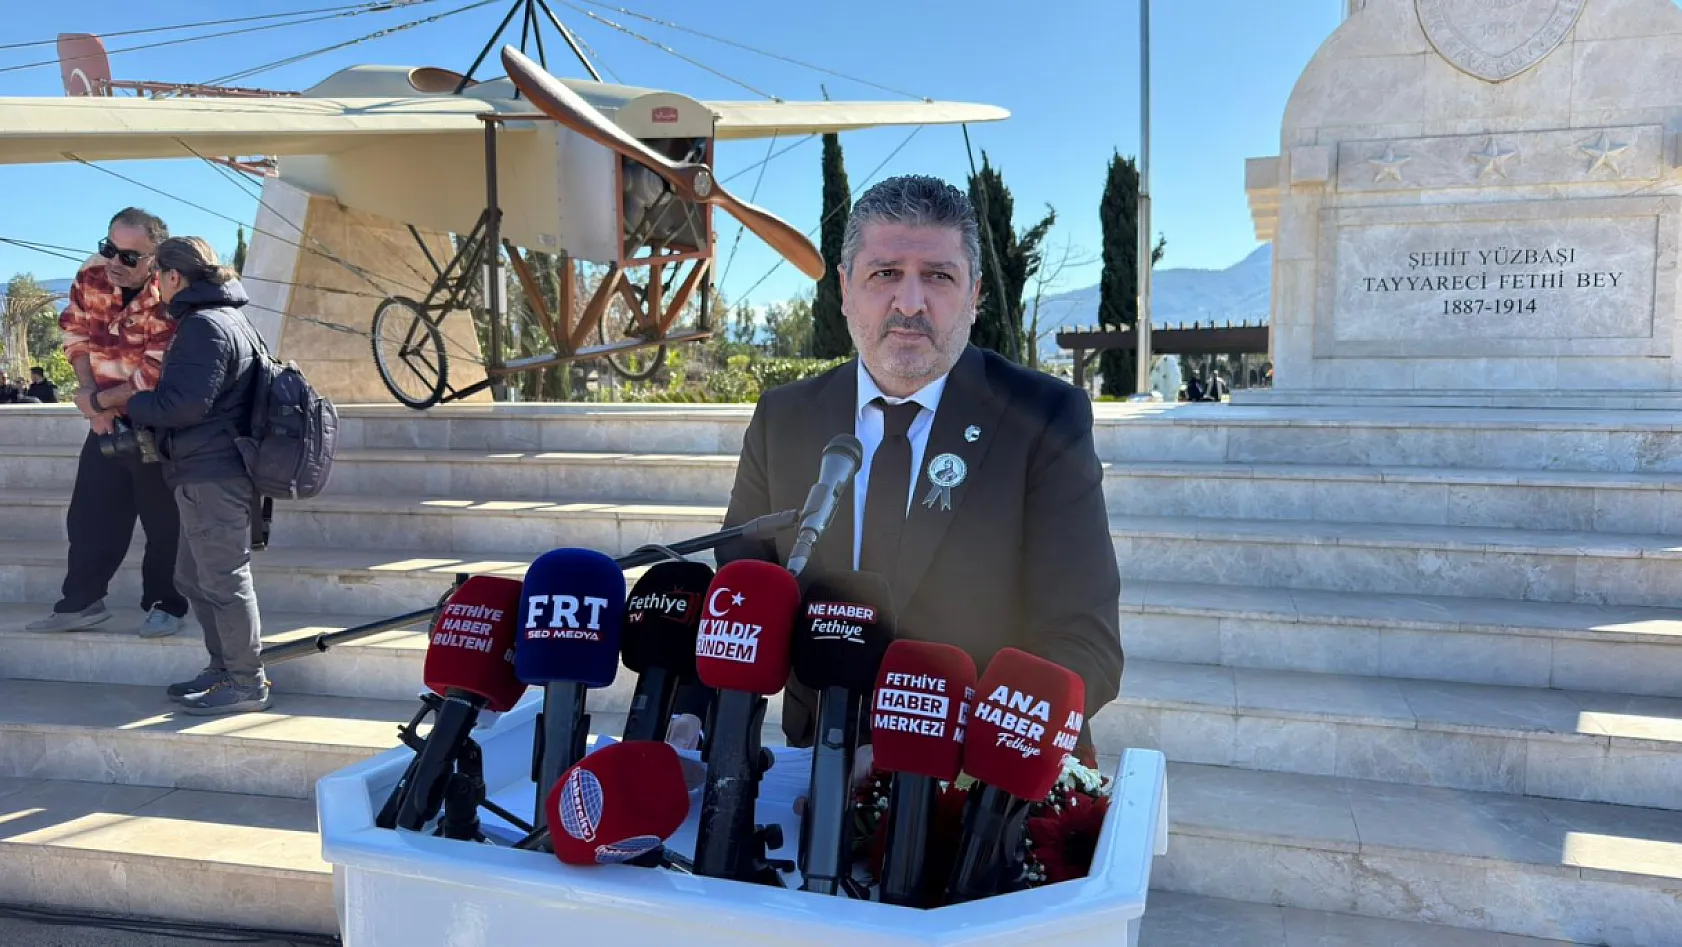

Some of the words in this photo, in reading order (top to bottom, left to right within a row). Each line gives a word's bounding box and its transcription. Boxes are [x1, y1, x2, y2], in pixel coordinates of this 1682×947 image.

[1408, 247, 1471, 269] ŞEHİT
[1479, 246, 1575, 267] YÜZBAŞI
[1363, 272, 1487, 292] TAYYARECİ
[1499, 271, 1564, 290] FETHİ
[1577, 271, 1624, 288] BEY
[1443, 299, 1537, 315] 1887-1914
[445, 603, 504, 621] FETHİYE
[525, 595, 608, 630] FRT
[628, 592, 688, 614] Fethiye
[808, 603, 826, 616] NE
[828, 604, 874, 621] HABER
[442, 618, 493, 636] HABER
[629, 612, 643, 623] TV
[811, 618, 863, 637] Fethiye
[553, 630, 599, 640] MEDYA
[711, 620, 762, 641] YILDIZ
[432, 631, 493, 653] BÜLTENİ
[885, 672, 946, 692] FETHİYE
[880, 691, 943, 715] HABER
[988, 685, 1051, 723] ANA
[874, 714, 946, 737] MERKEZİ
[974, 702, 1045, 742] HABER
